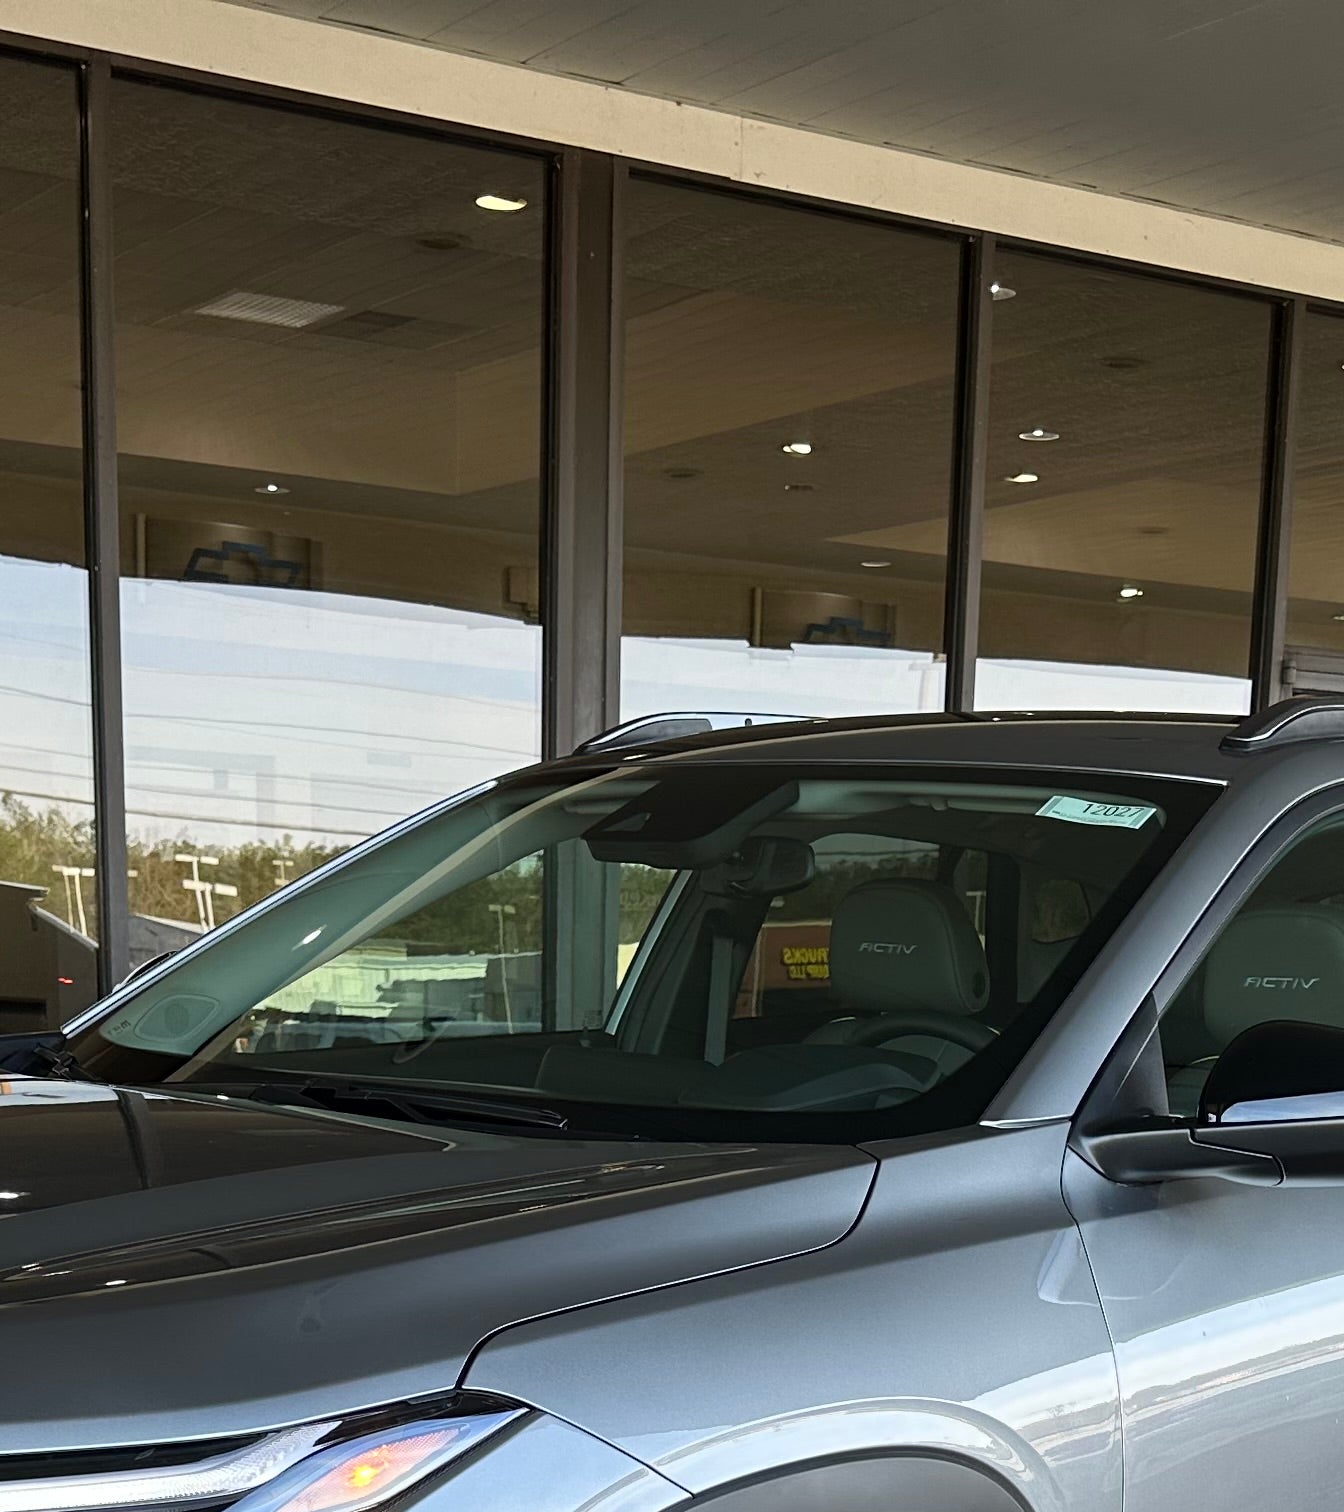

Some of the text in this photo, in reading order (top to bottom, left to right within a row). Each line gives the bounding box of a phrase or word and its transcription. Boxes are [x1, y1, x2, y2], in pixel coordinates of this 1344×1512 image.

[1082, 803, 1144, 818] 12027
[859, 943, 917, 954] ACTIV
[1243, 977, 1320, 989] ACTIV
